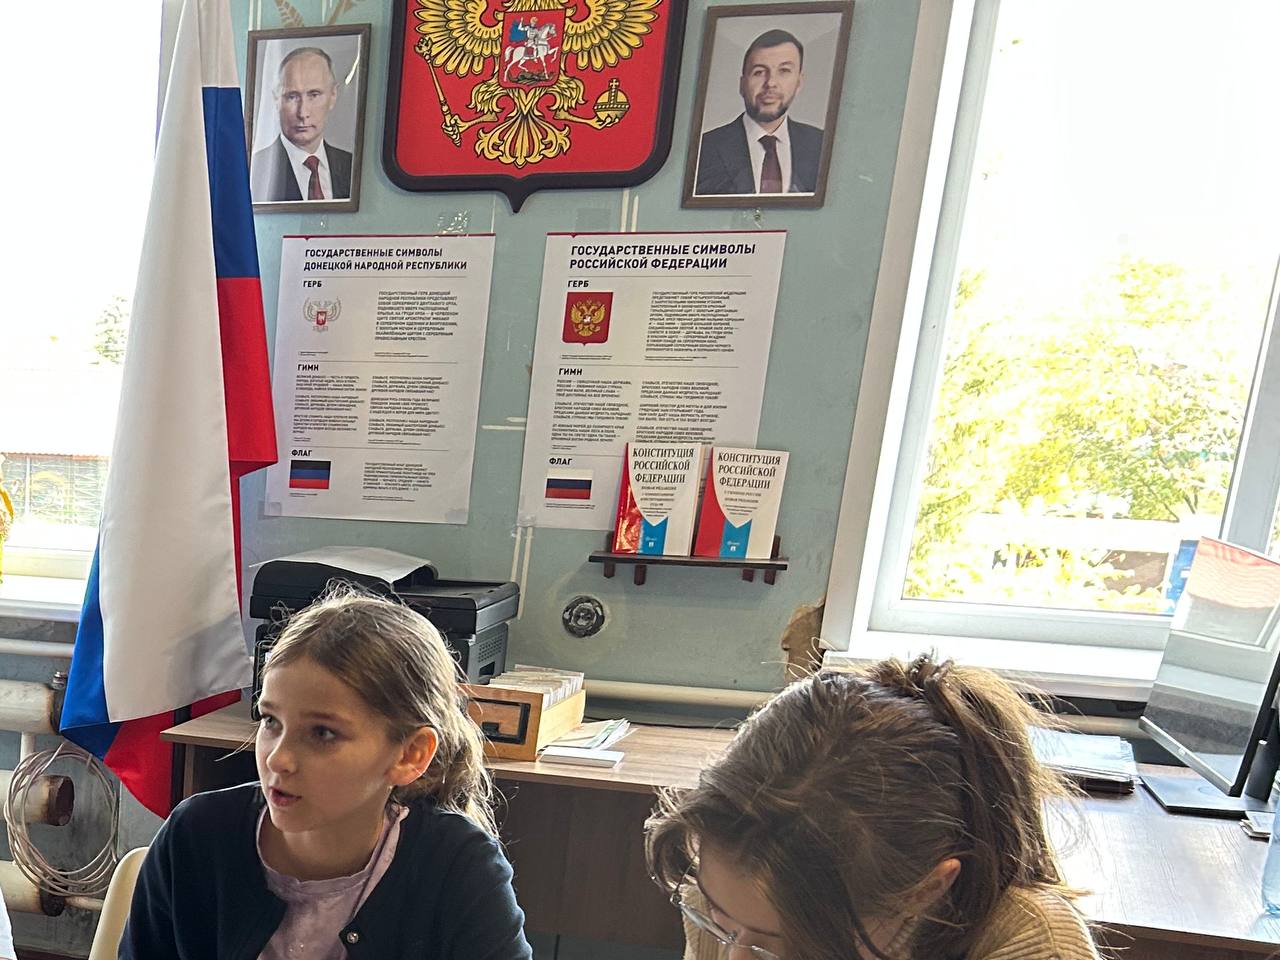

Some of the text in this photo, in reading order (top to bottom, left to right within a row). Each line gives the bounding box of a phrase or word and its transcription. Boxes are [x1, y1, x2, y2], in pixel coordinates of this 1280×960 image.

[305, 248, 443, 259] ГОСУДАРСТВЕННЫЕ СИМВОЛЫ
[571, 244, 756, 257] ГОСУДАРСТВЕННЫЕ СИМВОЛЫ
[303, 260, 467, 272] ДОНЕЦКОЙ НАРОДНОЙ РЕСПУБЛИКИ
[569, 256, 728, 271] РОССИЙСКОЙ ФЕДЕРАЦИИ
[303, 280, 322, 288] ГЕРБ
[567, 280, 589, 288] ГЕРБ
[297, 363, 319, 371] ГИМН
[558, 368, 583, 376] ГИМН
[291, 449, 313, 457] ФЛАГ
[632, 447, 695, 459] КОНСТИТУЦИЯ
[717, 452, 781, 465] КОНСТИТУЦИЯ
[548, 457, 573, 465] ФЛАГ
[633, 459, 691, 471] РОССИЙСКОЙ
[718, 464, 776, 478] РОССИЙСКОЙ
[634, 472, 686, 484] ФЕДЕРАЦИИ
[719, 476, 771, 490] ФЕДЕРАЦИИ
